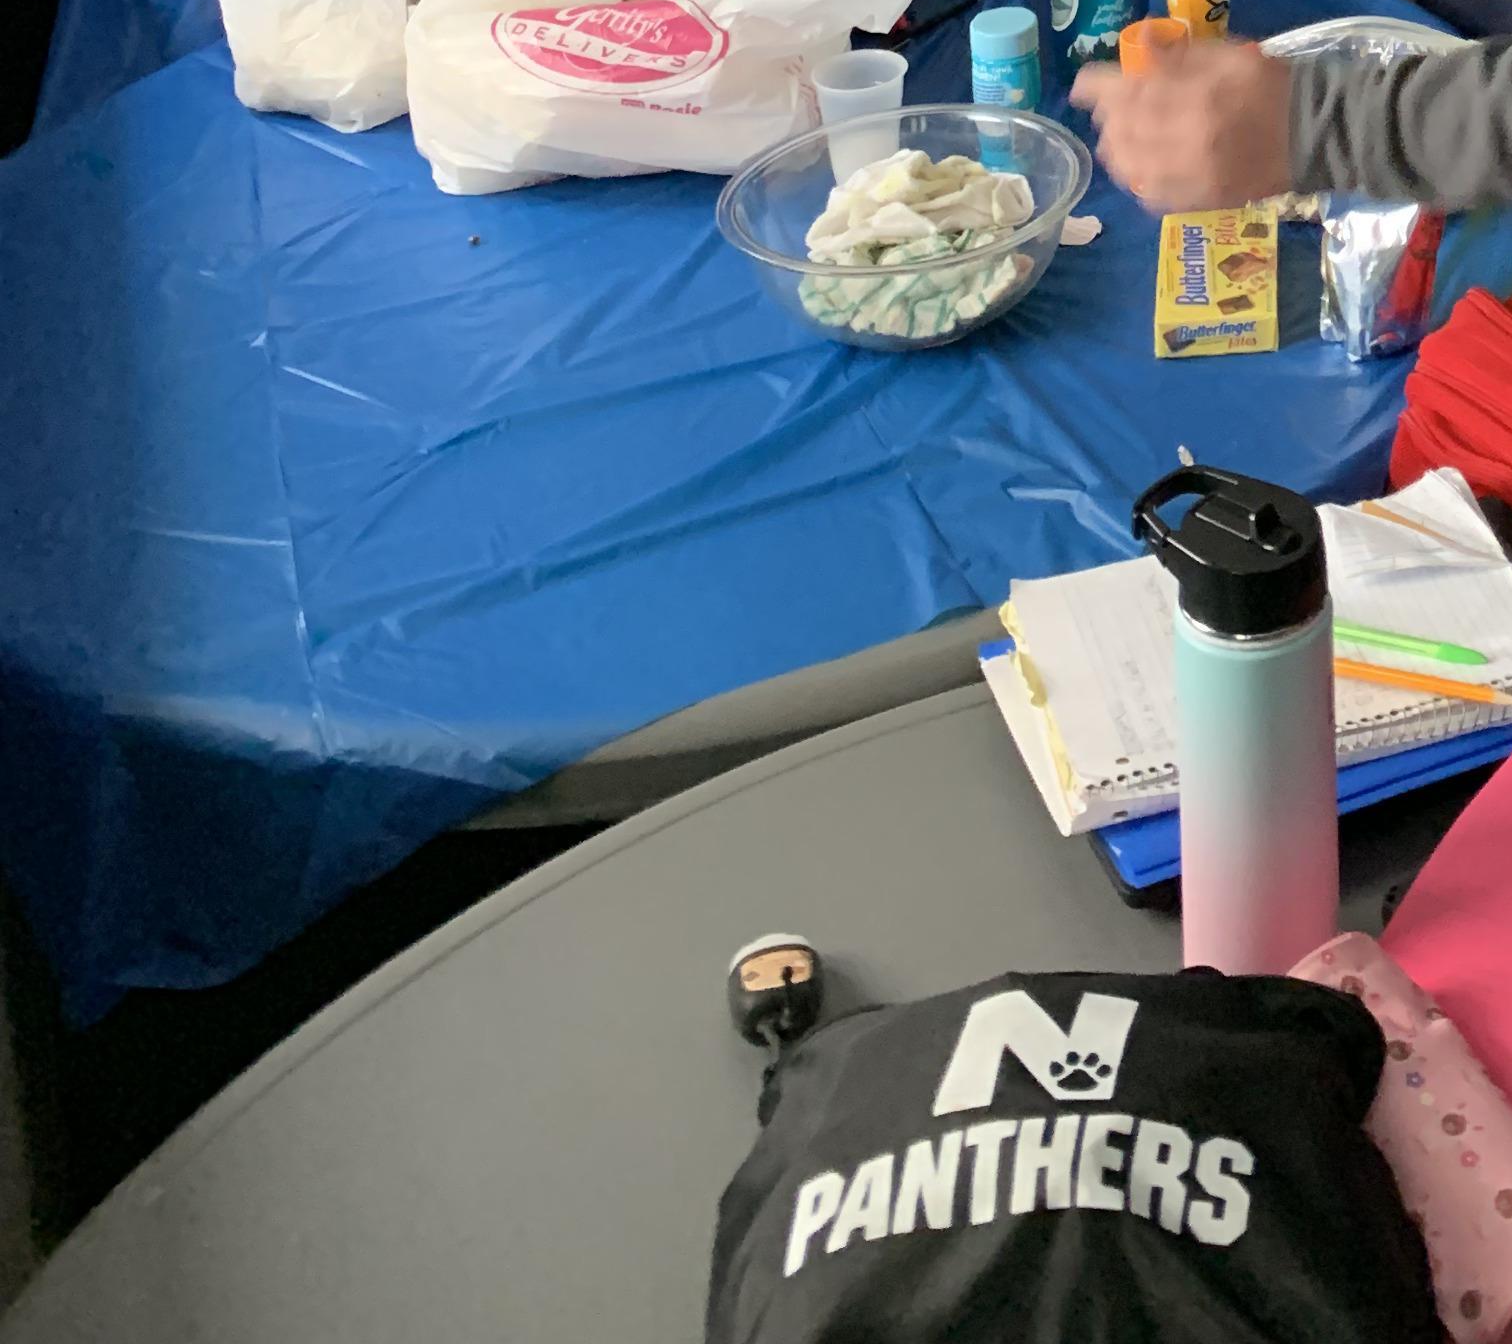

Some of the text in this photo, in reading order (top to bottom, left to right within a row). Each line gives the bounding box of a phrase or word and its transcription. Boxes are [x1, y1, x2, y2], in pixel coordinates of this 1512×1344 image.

[1175, 223, 1211, 306] Butterfinger
[1178, 320, 1257, 342] Butterfinger
[932, 990, 1140, 1118] N
[784, 1113, 1257, 1279] PANTHERS
